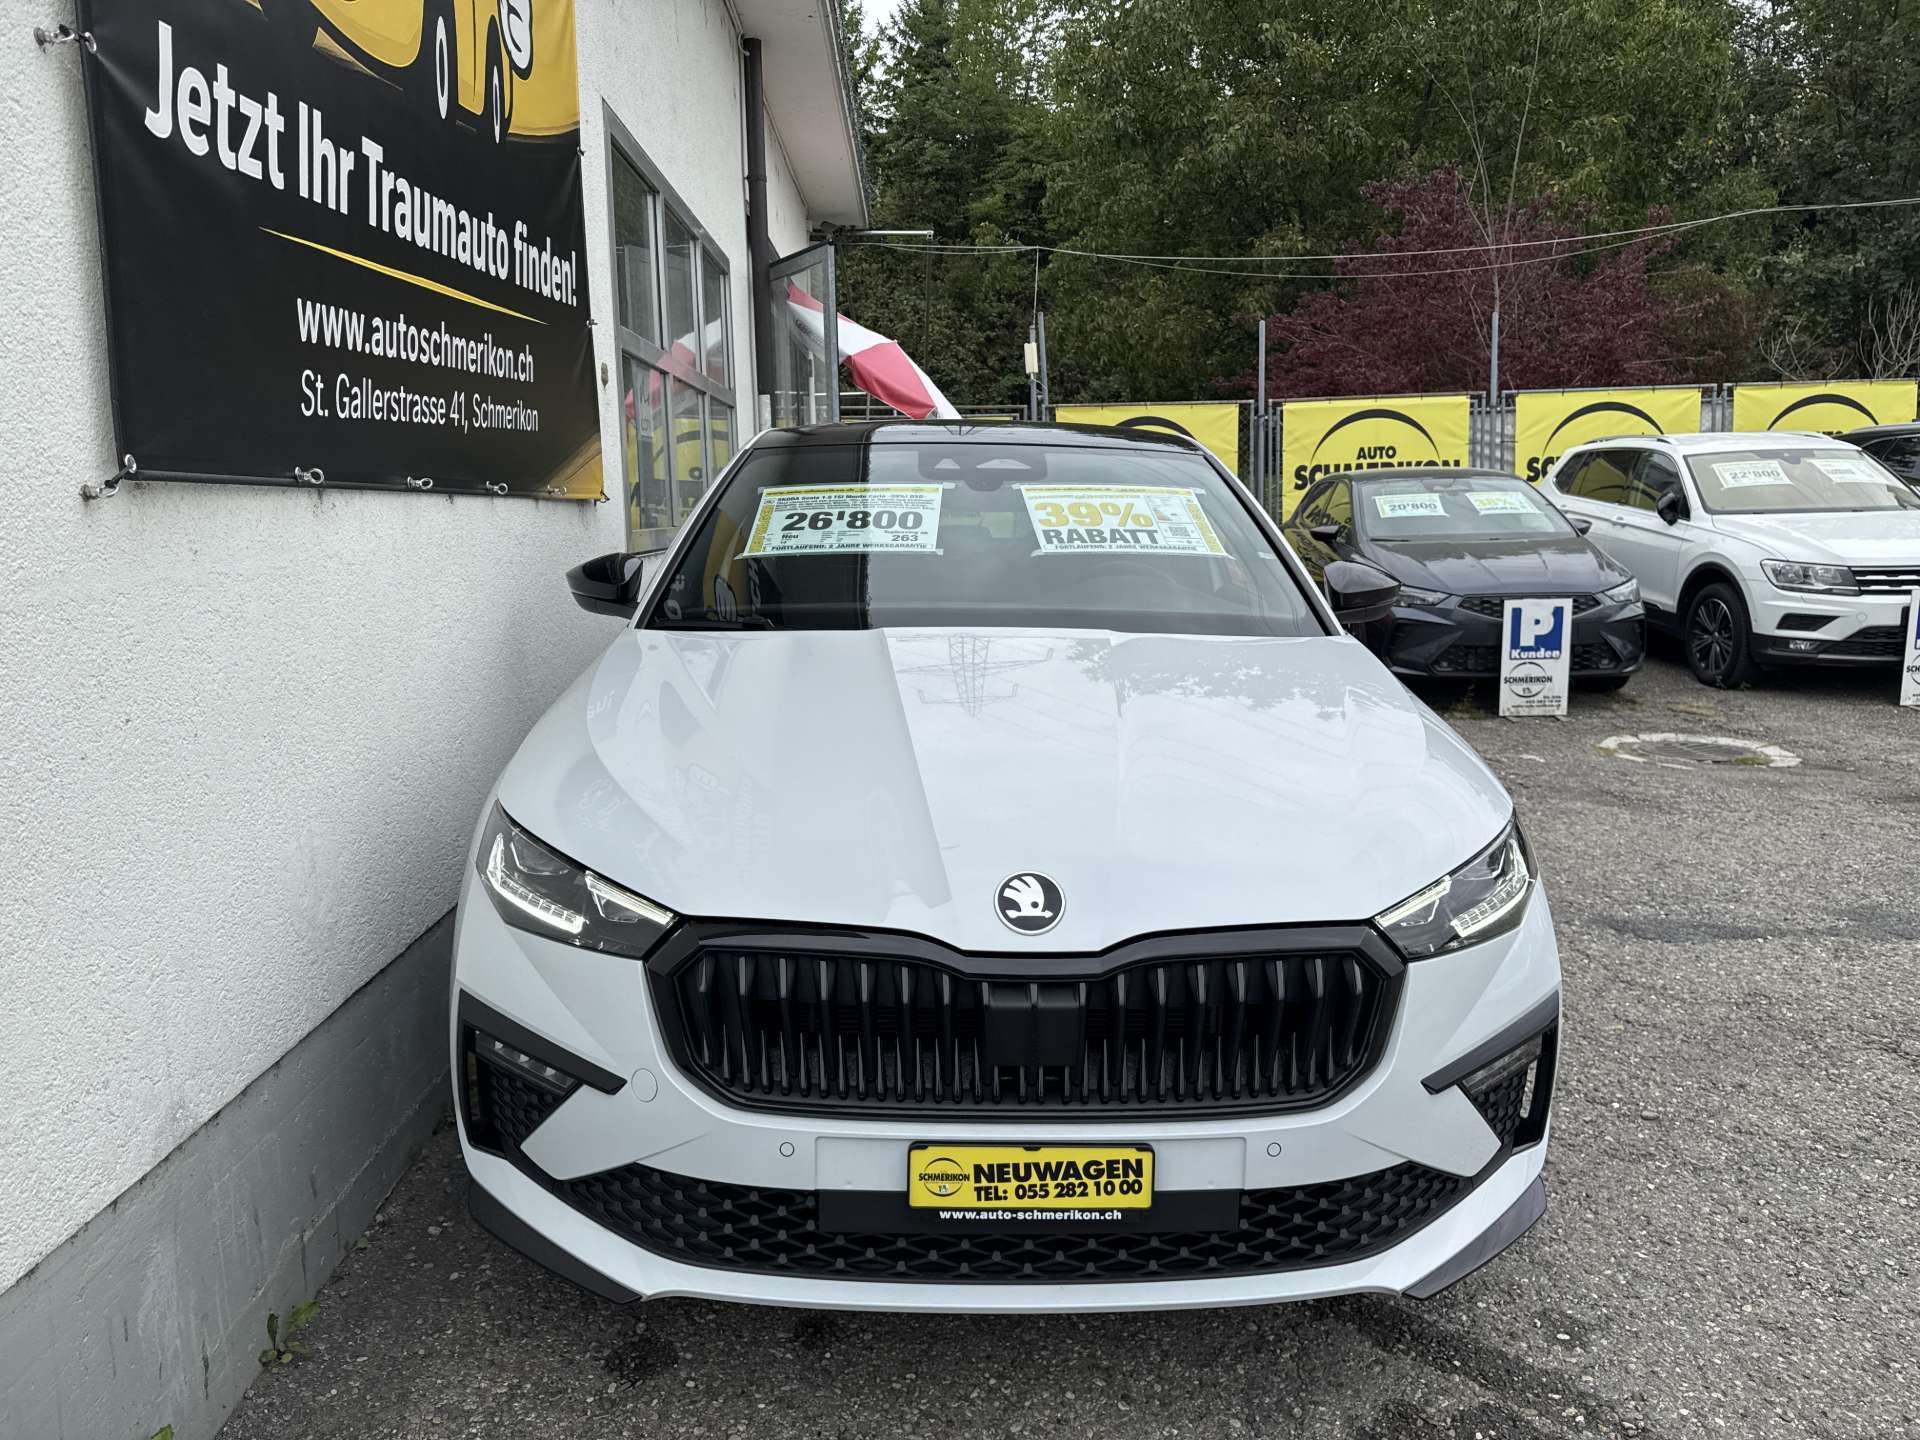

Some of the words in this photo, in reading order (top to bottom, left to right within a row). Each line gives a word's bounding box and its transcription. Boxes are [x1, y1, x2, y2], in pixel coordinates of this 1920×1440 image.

[145, 20, 285, 191] Jetzt
[299, 101, 355, 215] Ihr
[361, 136, 509, 281] Traumauto
[514, 220, 577, 306] finden!
[297, 298, 535, 384] www.autoschmerikon.ch
[301, 370, 329, 418] St.
[336, 374, 446, 424] Gallerstrasse
[450, 391, 468, 434] 41,
[472, 394, 539, 432] Schmerikon
[1356, 446, 1397, 460] AUTO
[1034, 502, 1154, 528] 39%
[1389, 502, 1438, 512] 20'800
[781, 510, 924, 532] 26'800
[891, 534, 919, 542] 263
[1042, 528, 1159, 545] RABATT
[1510, 648, 1561, 659] Kunden
[1503, 675, 1553, 684] SCHMERIKON
[918, 1172, 970, 1182] SCHMERIKON
[973, 1158, 1144, 1184] NEUWAGEN
[974, 1185, 1009, 1202] TEL:
[1014, 1183, 1050, 1200] 055
[1053, 1182, 1089, 1198] 282
[1095, 1180, 1116, 1197] 10
[1118, 1178, 1143, 1195] 00
[939, 1209, 1122, 1221] www.auto-schmerikon.ch
